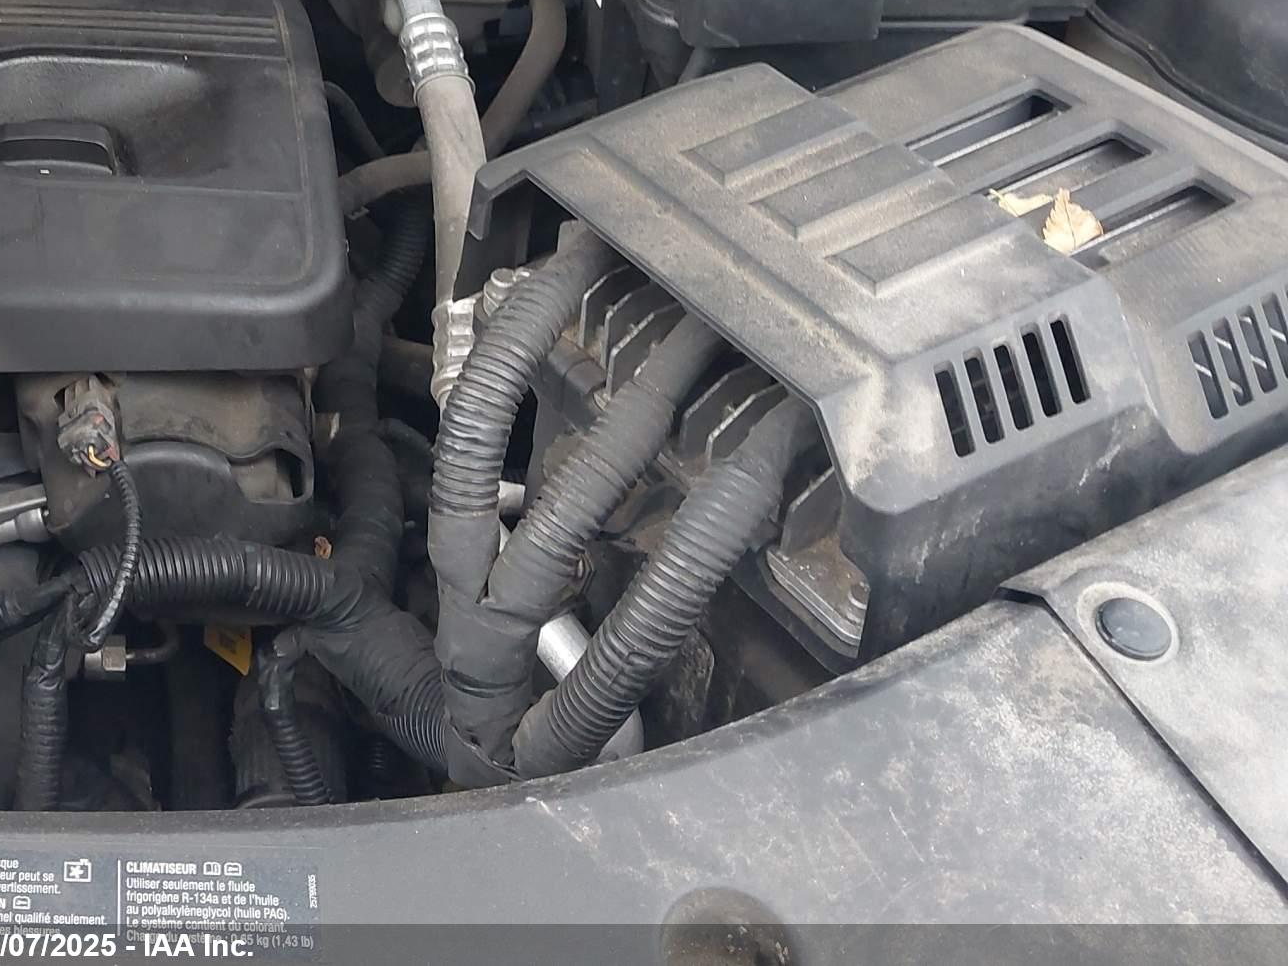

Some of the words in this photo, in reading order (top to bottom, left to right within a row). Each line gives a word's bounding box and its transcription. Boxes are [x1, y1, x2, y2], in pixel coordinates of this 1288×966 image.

[126, 861, 197, 875] CLIMATISEUR
[18, 872, 40, 883] peut
[42, 873, 54, 882] se
[126, 877, 160, 890] Utiliser
[162, 878, 214, 891] seulement
[216, 880, 226, 892] le
[227, 881, 256, 892] fluide
[126, 890, 179, 905] frigorigène
[181, 892, 218, 904] R-134a
[221, 895, 232, 905] et
[234, 894, 246, 905] de
[249, 895, 280, 907] l'huile
[15, 913, 51, 925] qualifié
[53, 914, 107, 925] seulement.
[126, 907, 139, 915] au
[141, 905, 231, 919] polyalkylèneglycol
[233, 907, 261, 920] (huile
[263, 908, 290, 921] PAG).
[126, 917, 139, 928] Le
[141, 918, 183, 931] système
[185, 920, 226, 931] contient
[228, 921, 241, 932] du
[243, 921, 287, 933] colorant.
[256, 934, 269, 948] kg
